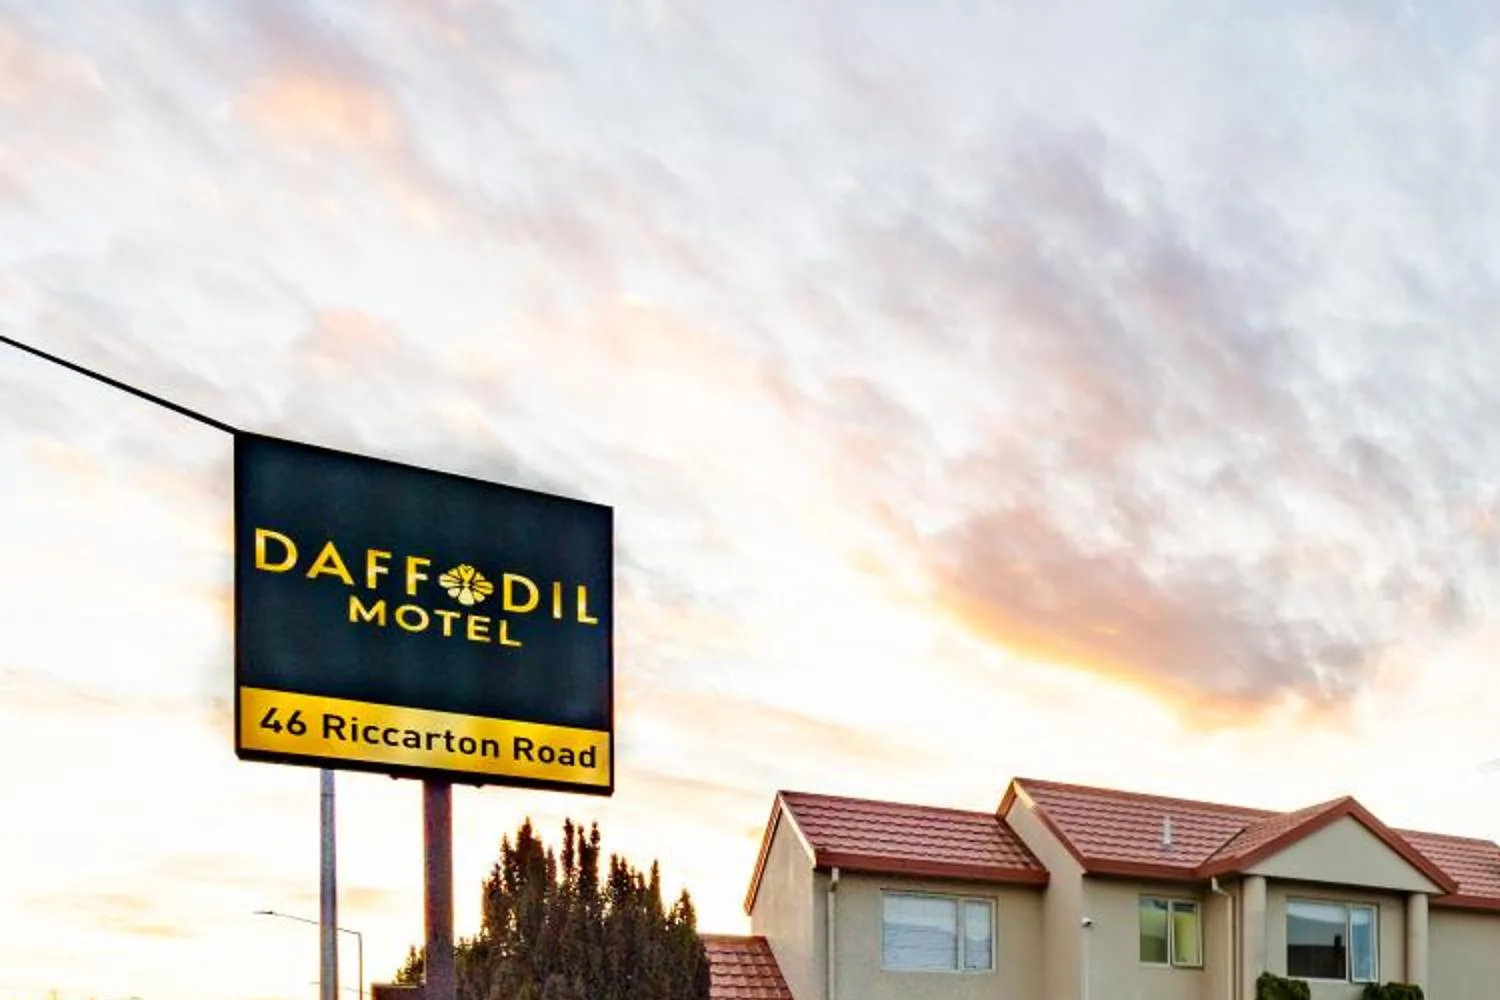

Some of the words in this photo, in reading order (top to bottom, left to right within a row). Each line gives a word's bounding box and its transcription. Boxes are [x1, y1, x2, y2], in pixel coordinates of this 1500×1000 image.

[348, 595, 522, 647] MOTEL
[260, 706, 307, 736] 46
[322, 713, 499, 758] Riccarton
[513, 737, 597, 769] Road
